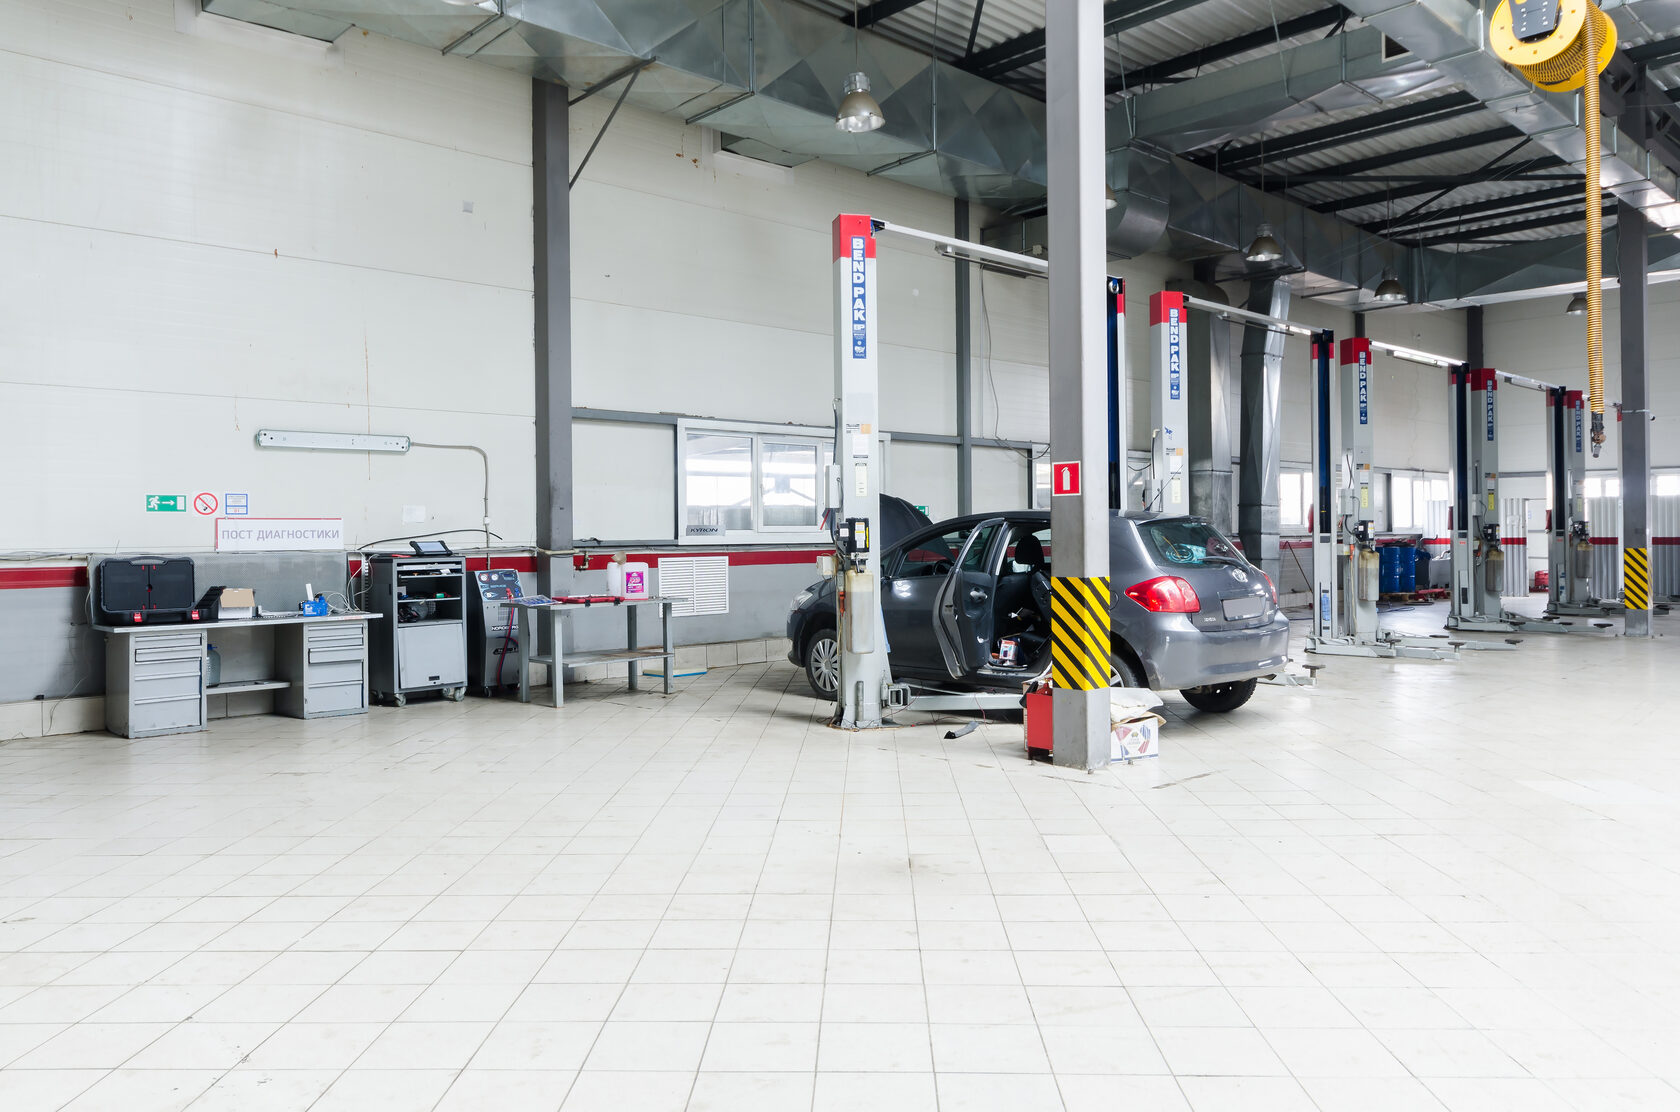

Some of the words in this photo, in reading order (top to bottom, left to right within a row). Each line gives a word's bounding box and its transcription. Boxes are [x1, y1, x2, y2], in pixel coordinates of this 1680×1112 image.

[852, 237, 864, 284] BEND
[853, 286, 865, 321] PAK
[1169, 308, 1179, 343] BEND
[1170, 345, 1180, 371] PAK
[222, 530, 253, 540] ПОСТ
[257, 529, 340, 541] ДИАГНОСТИКИ
